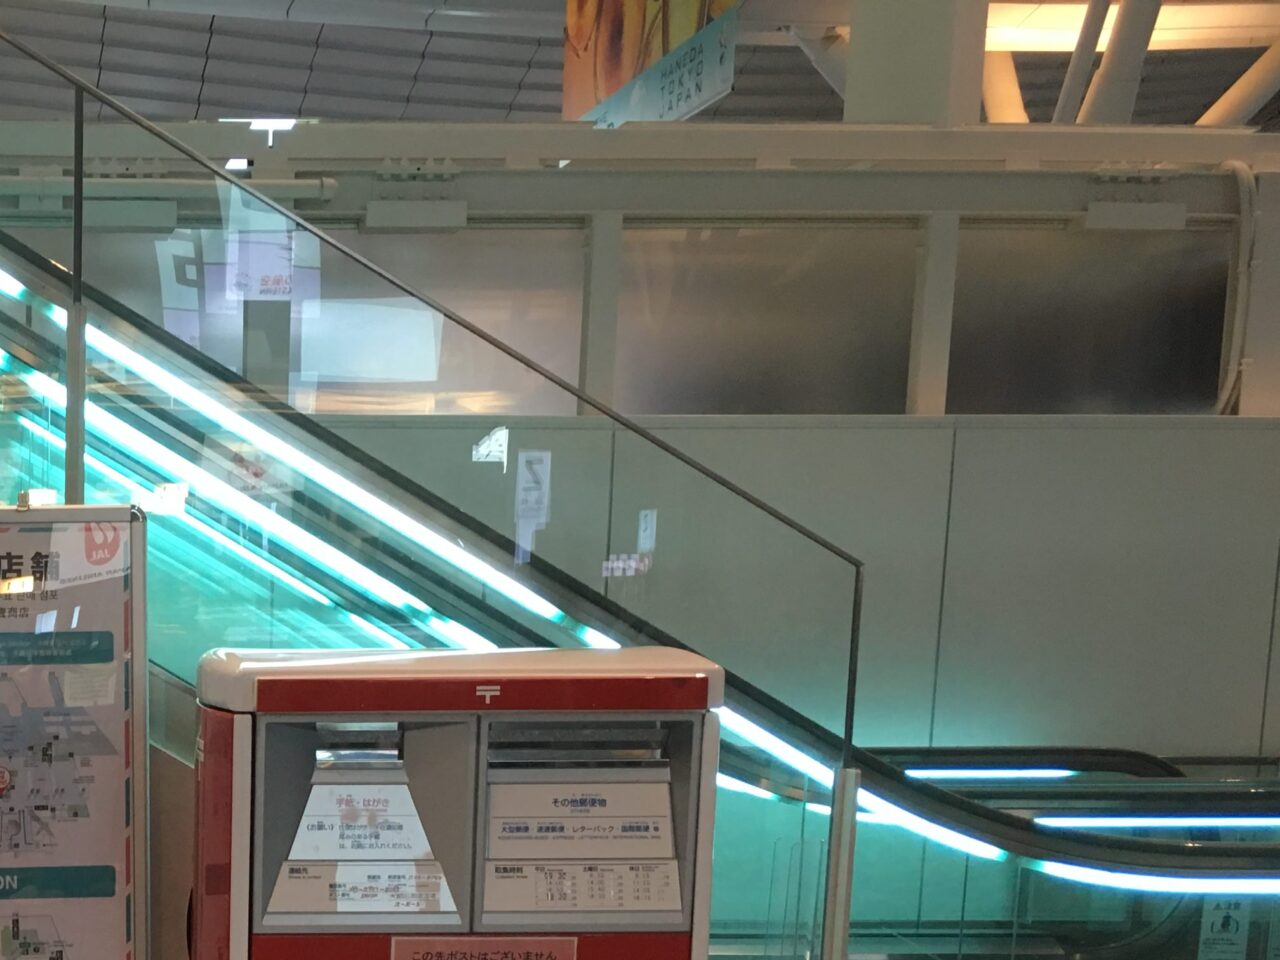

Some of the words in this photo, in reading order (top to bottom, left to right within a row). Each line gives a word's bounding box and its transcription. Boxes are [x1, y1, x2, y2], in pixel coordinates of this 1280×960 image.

[659, 60, 704, 97] TOKYO
[661, 43, 704, 81] HANEDA
[659, 80, 703, 119] JAPAN
[551, 797, 608, 809] その他郵便物
